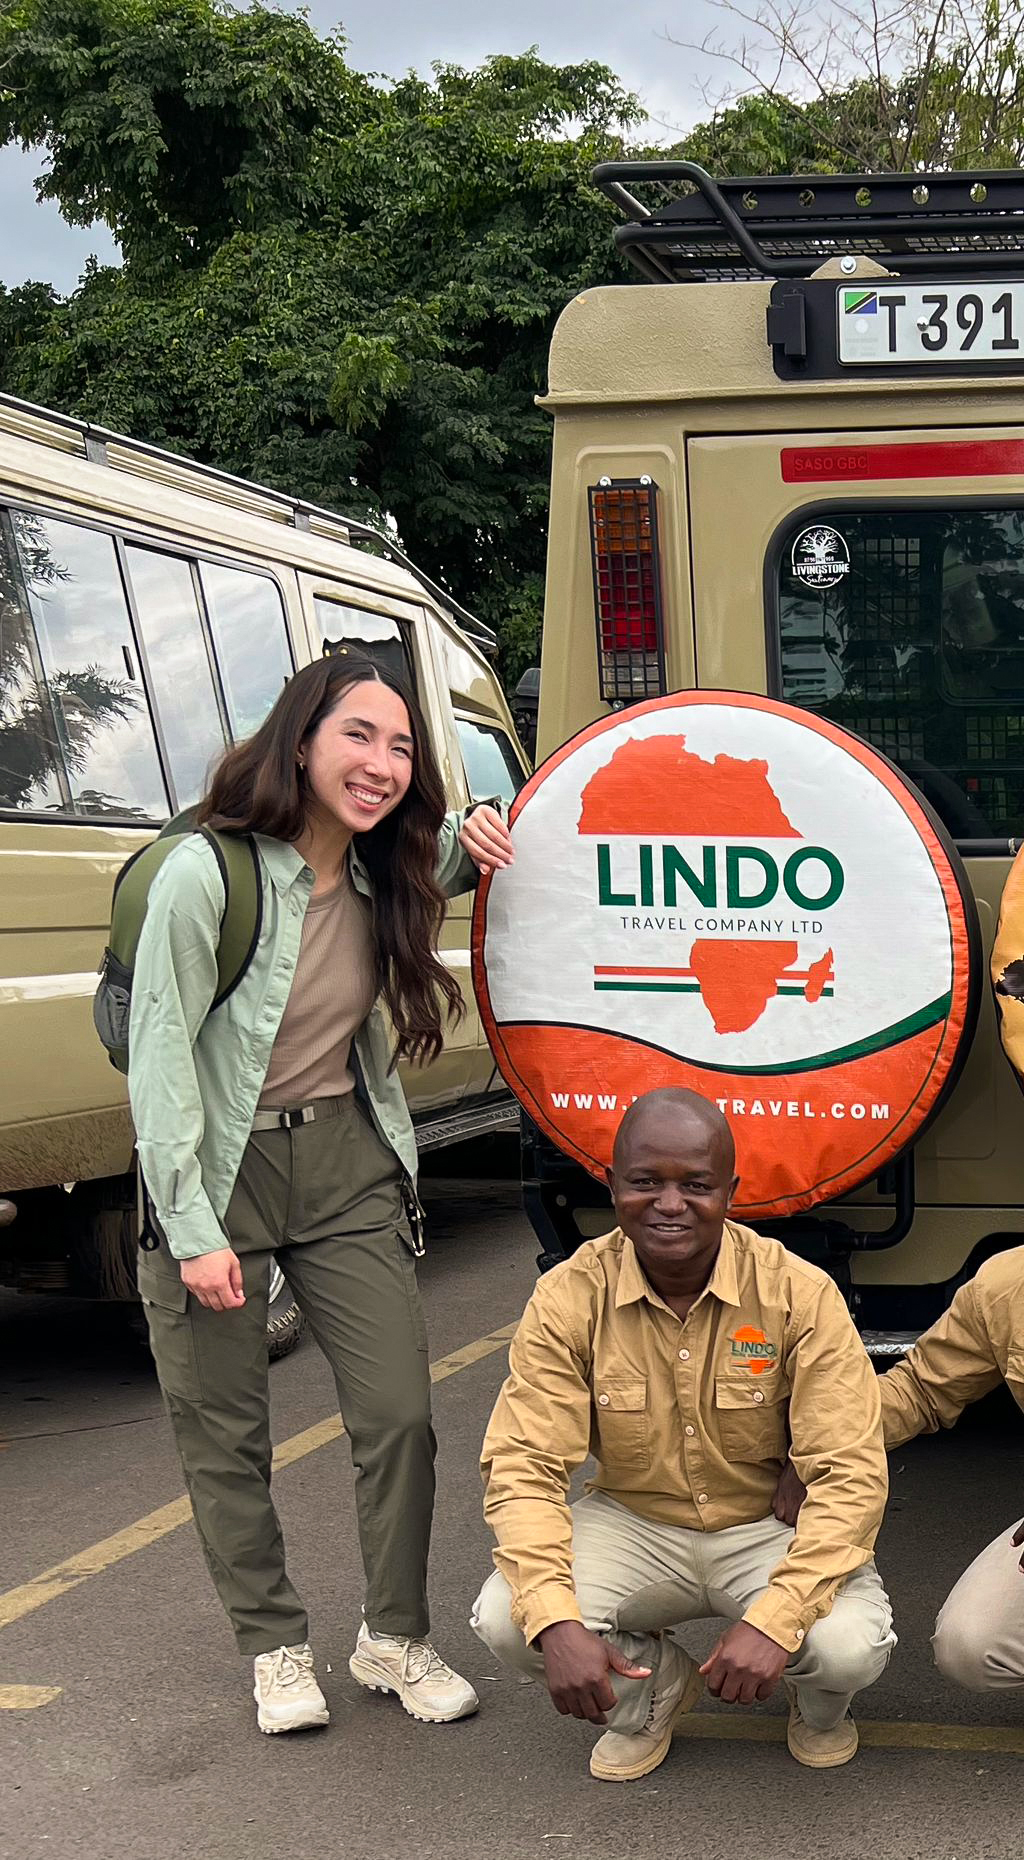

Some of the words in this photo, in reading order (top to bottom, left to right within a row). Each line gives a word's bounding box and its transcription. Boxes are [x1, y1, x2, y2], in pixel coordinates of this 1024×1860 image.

[879, 295, 907, 353] T
[920, 292, 1019, 352] 391
[794, 458, 834, 471] SASO
[837, 455, 867, 469] GBC
[792, 563, 850, 576] LIVINGSTONE
[597, 843, 845, 911] LINDO
[620, 916, 687, 931] TRAVEL
[694, 918, 784, 933] COMPANY
[791, 920, 824, 934] LTD
[731, 1341, 776, 1355] LINDO
